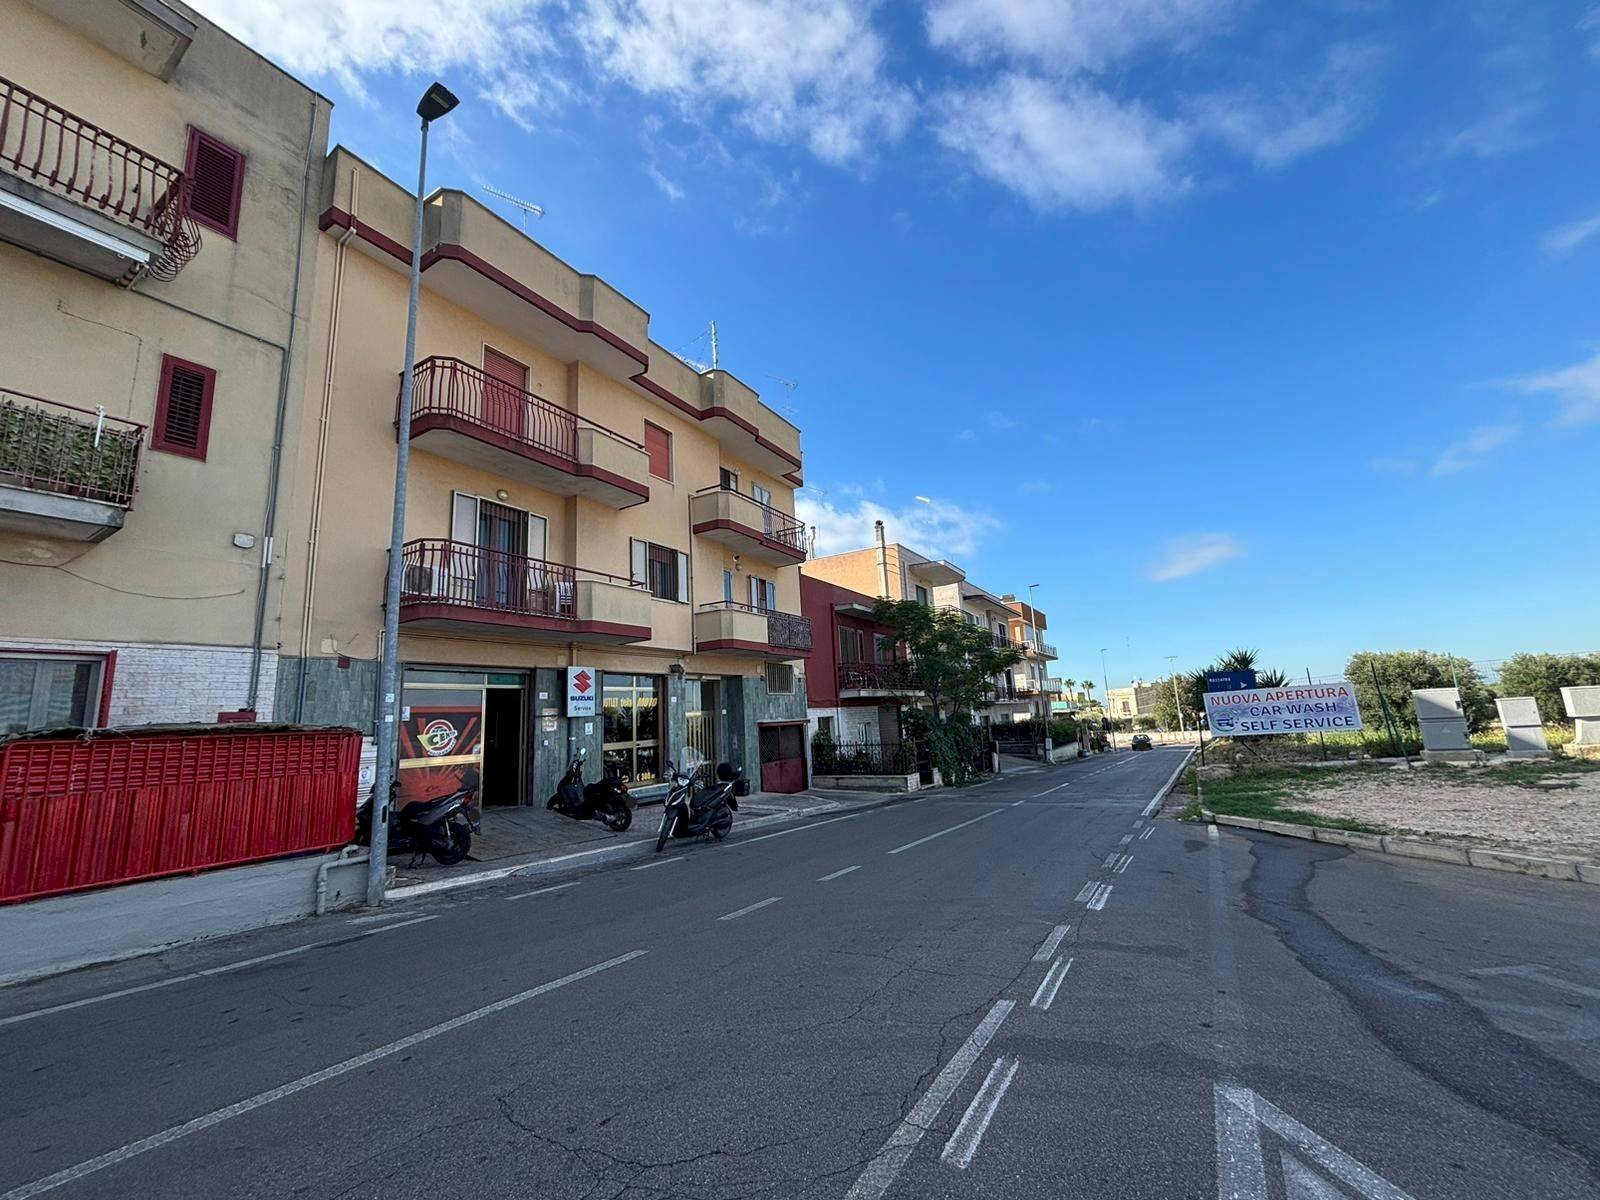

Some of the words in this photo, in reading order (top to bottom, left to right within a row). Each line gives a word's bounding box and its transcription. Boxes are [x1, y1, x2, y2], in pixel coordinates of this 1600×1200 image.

[637, 697, 658, 707] MOTO
[1210, 693, 1262, 706] NUOVA
[1265, 686, 1349, 702] APERTURA
[1250, 705, 1282, 717] CAR
[1286, 702, 1337, 714] WASH
[1241, 719, 1278, 732] SELF
[1283, 716, 1355, 729] SERVICE
